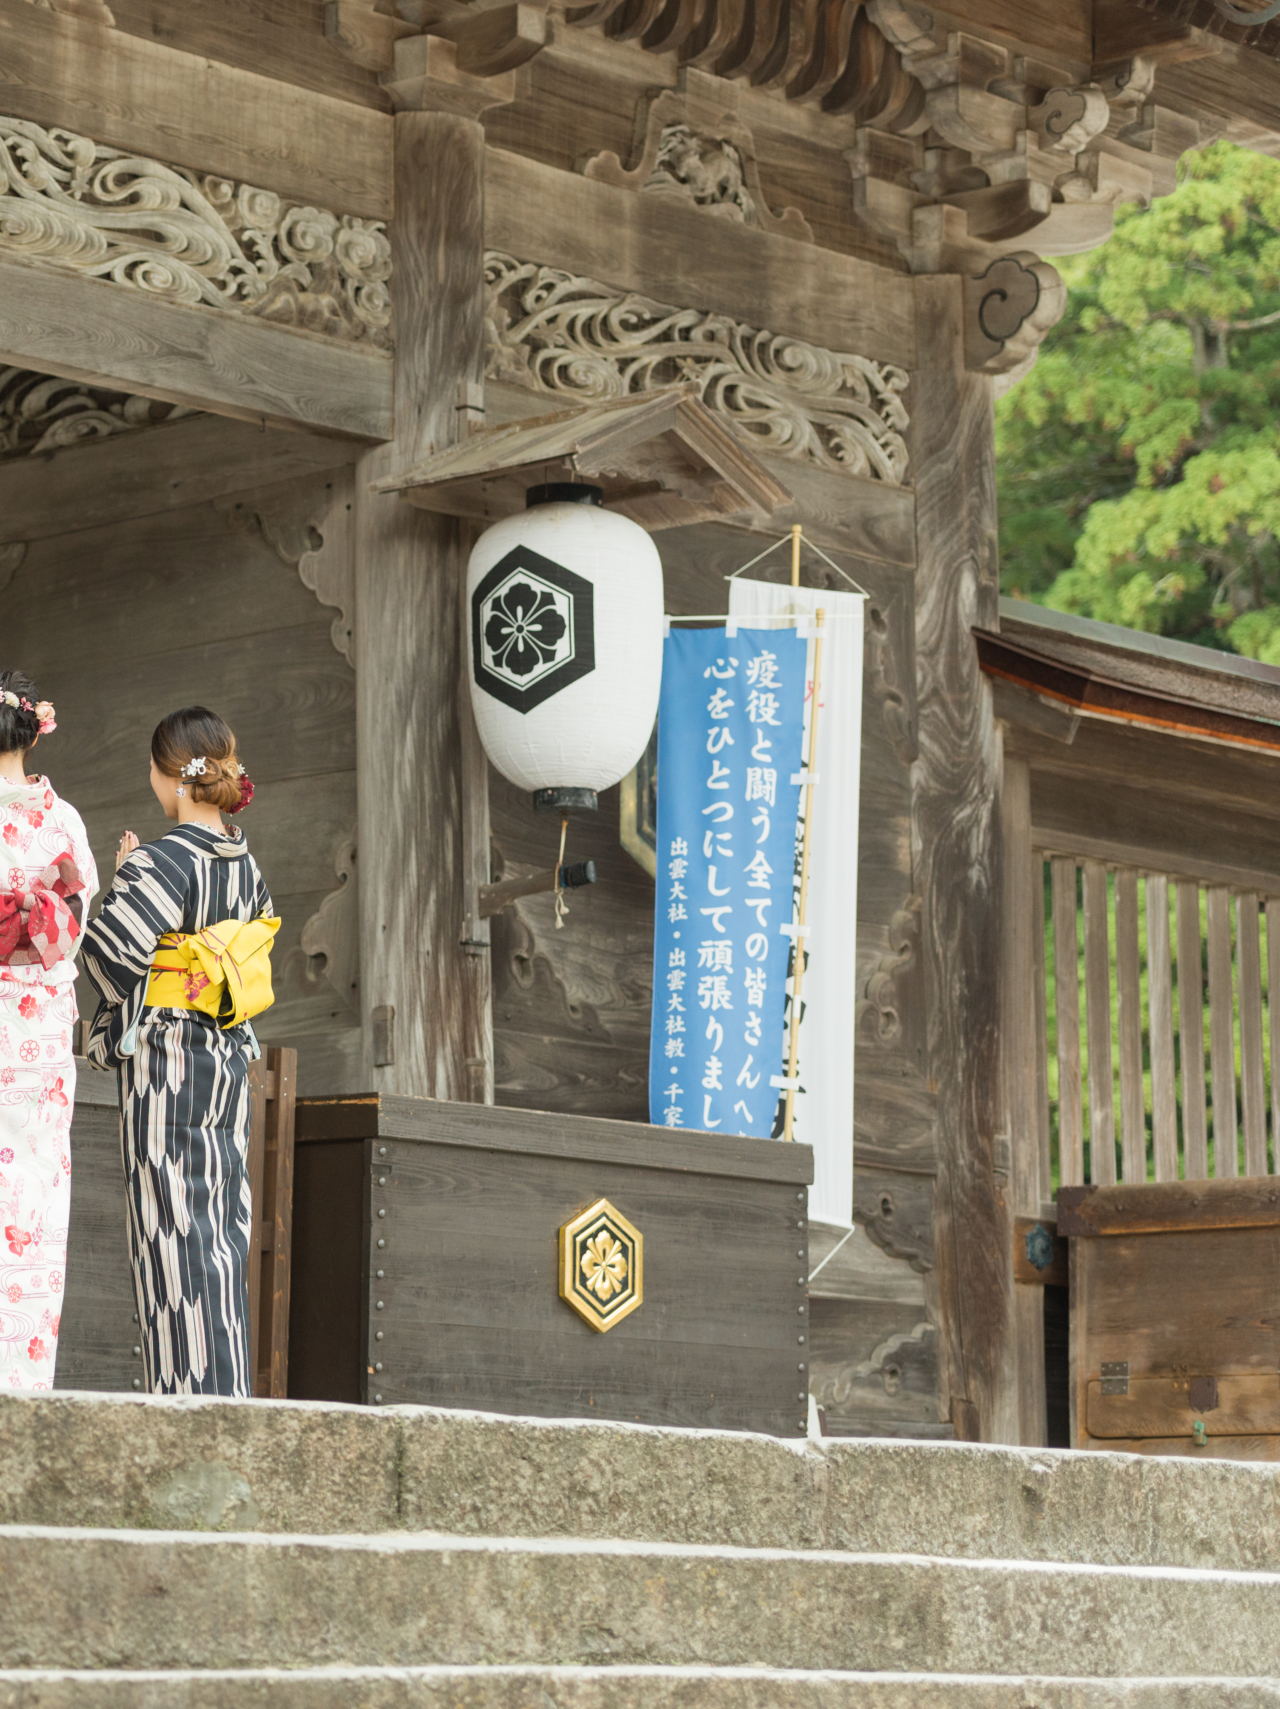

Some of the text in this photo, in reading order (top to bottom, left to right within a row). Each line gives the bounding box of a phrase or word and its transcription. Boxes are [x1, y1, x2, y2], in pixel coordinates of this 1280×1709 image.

[697, 656, 739, 1129] 心をひとつにして頑張りまし
[733, 650, 783, 1136] 疫役と闘う全ての皆さんへ
